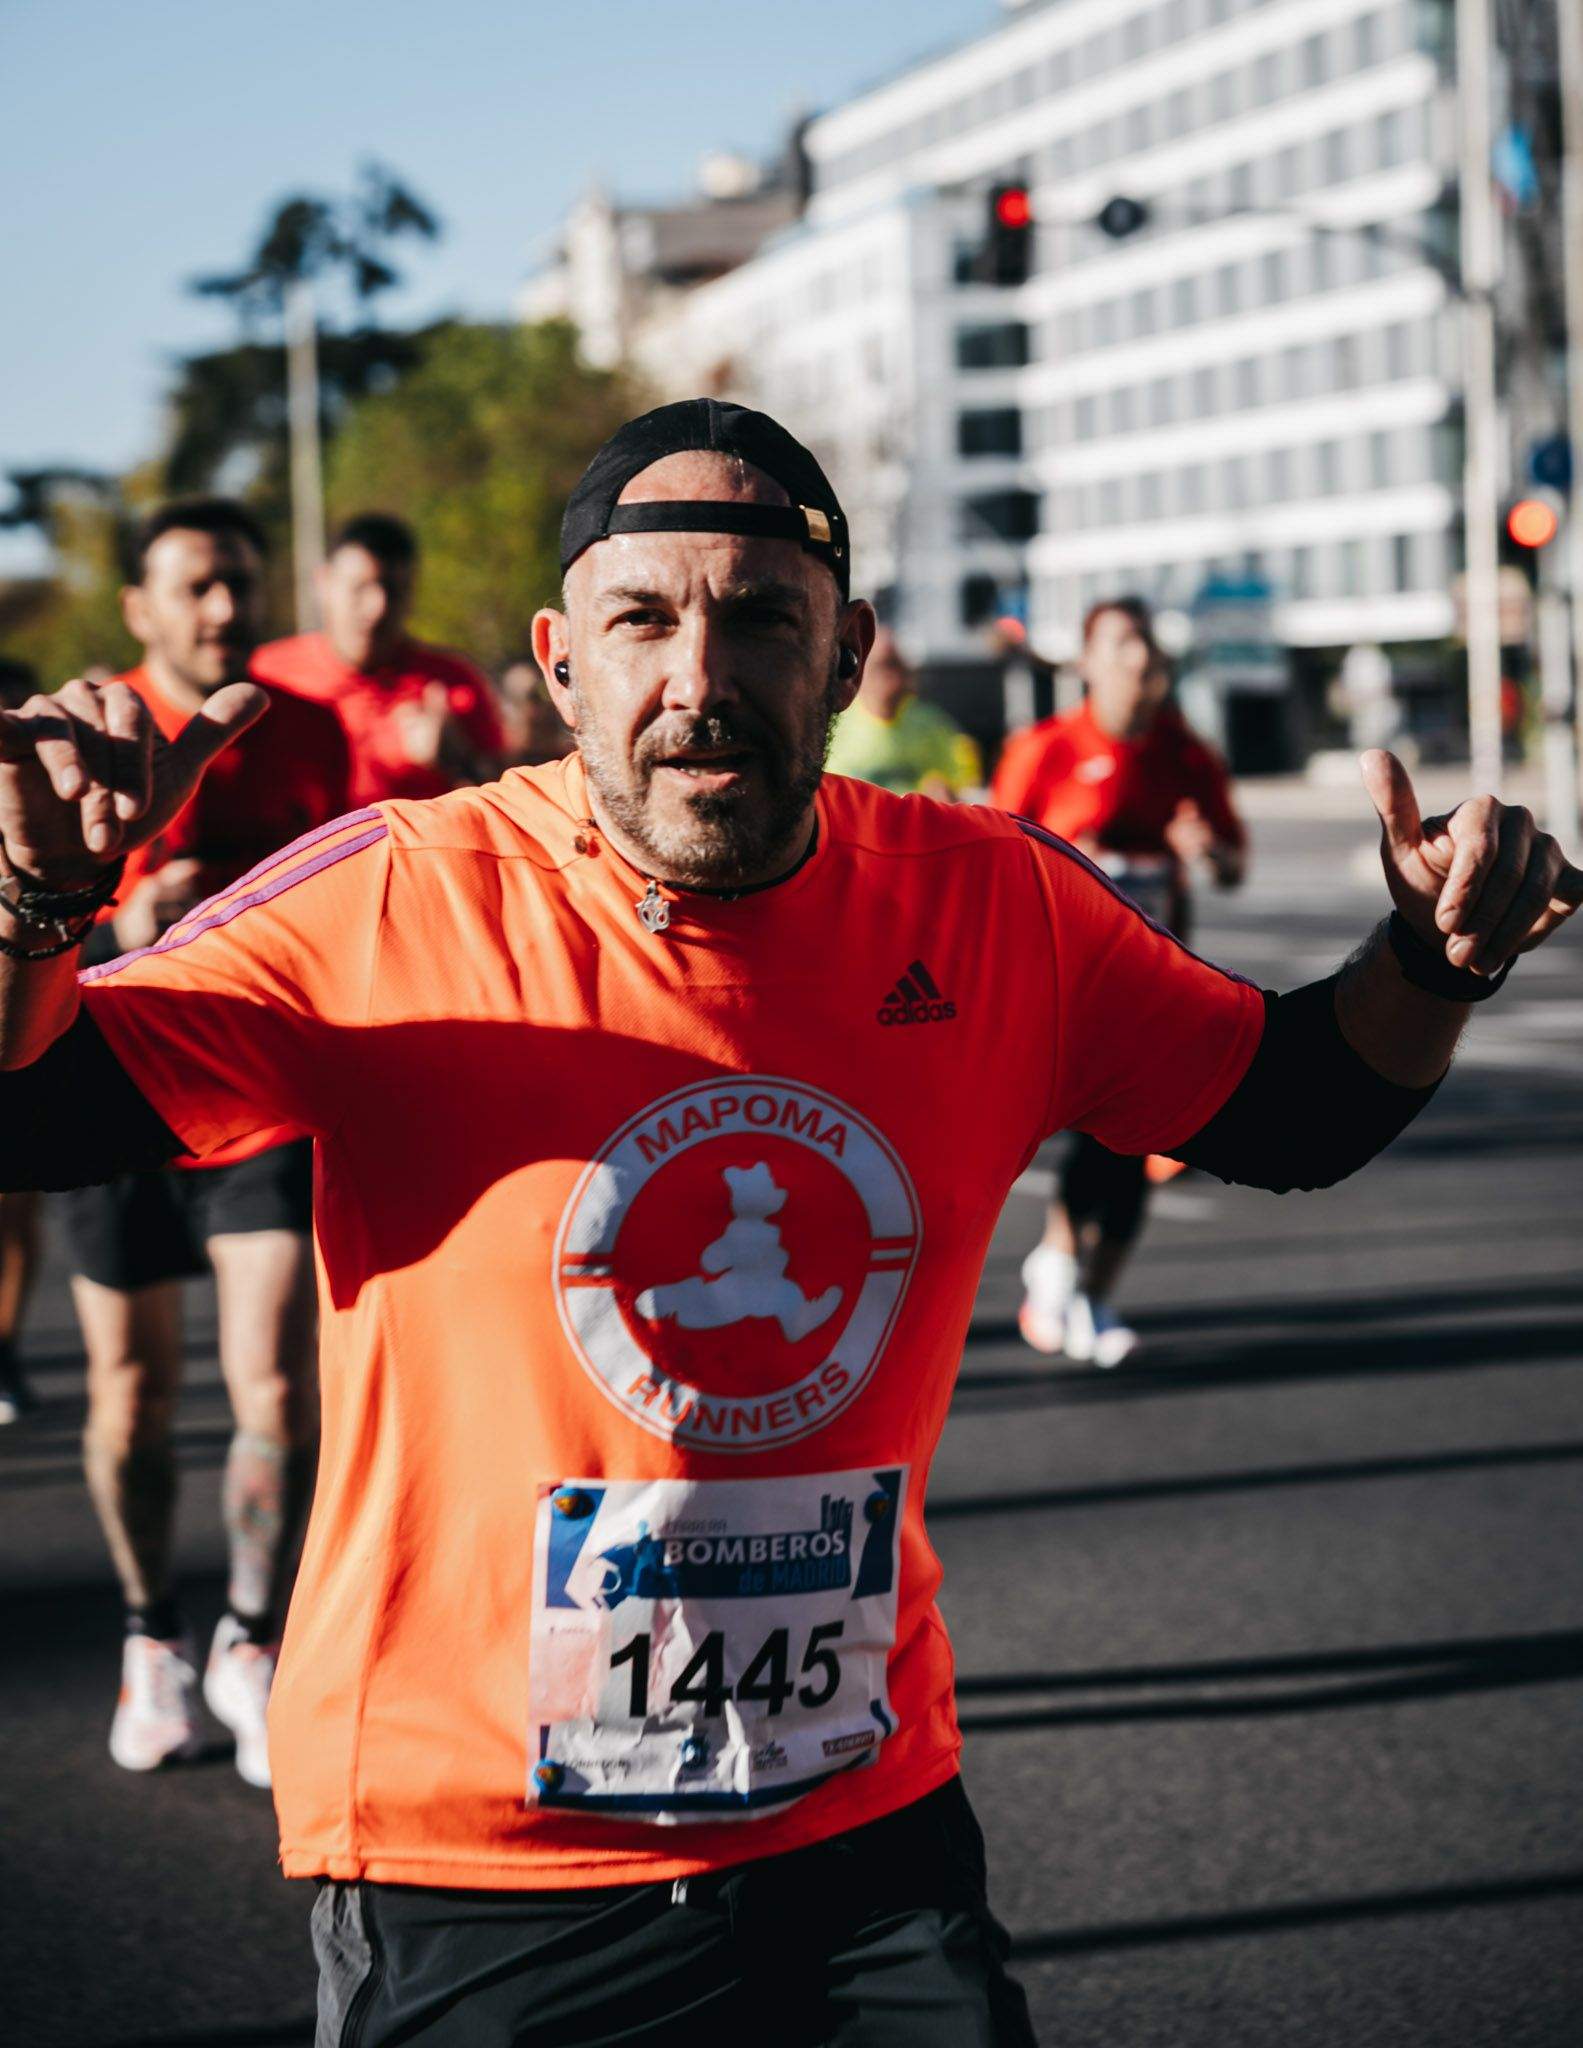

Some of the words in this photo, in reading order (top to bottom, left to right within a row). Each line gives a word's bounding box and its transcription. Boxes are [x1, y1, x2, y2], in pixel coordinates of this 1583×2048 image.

[877, 999, 957, 1025] adidas
[634, 1094, 848, 1164] MAPOMA
[627, 1361, 850, 1436] RUNNERS
[663, 1529, 846, 1567] BOMBEROS
[738, 1566, 766, 1593] de
[771, 1556, 848, 1592] MADRID
[610, 1620, 845, 1718] 1445
